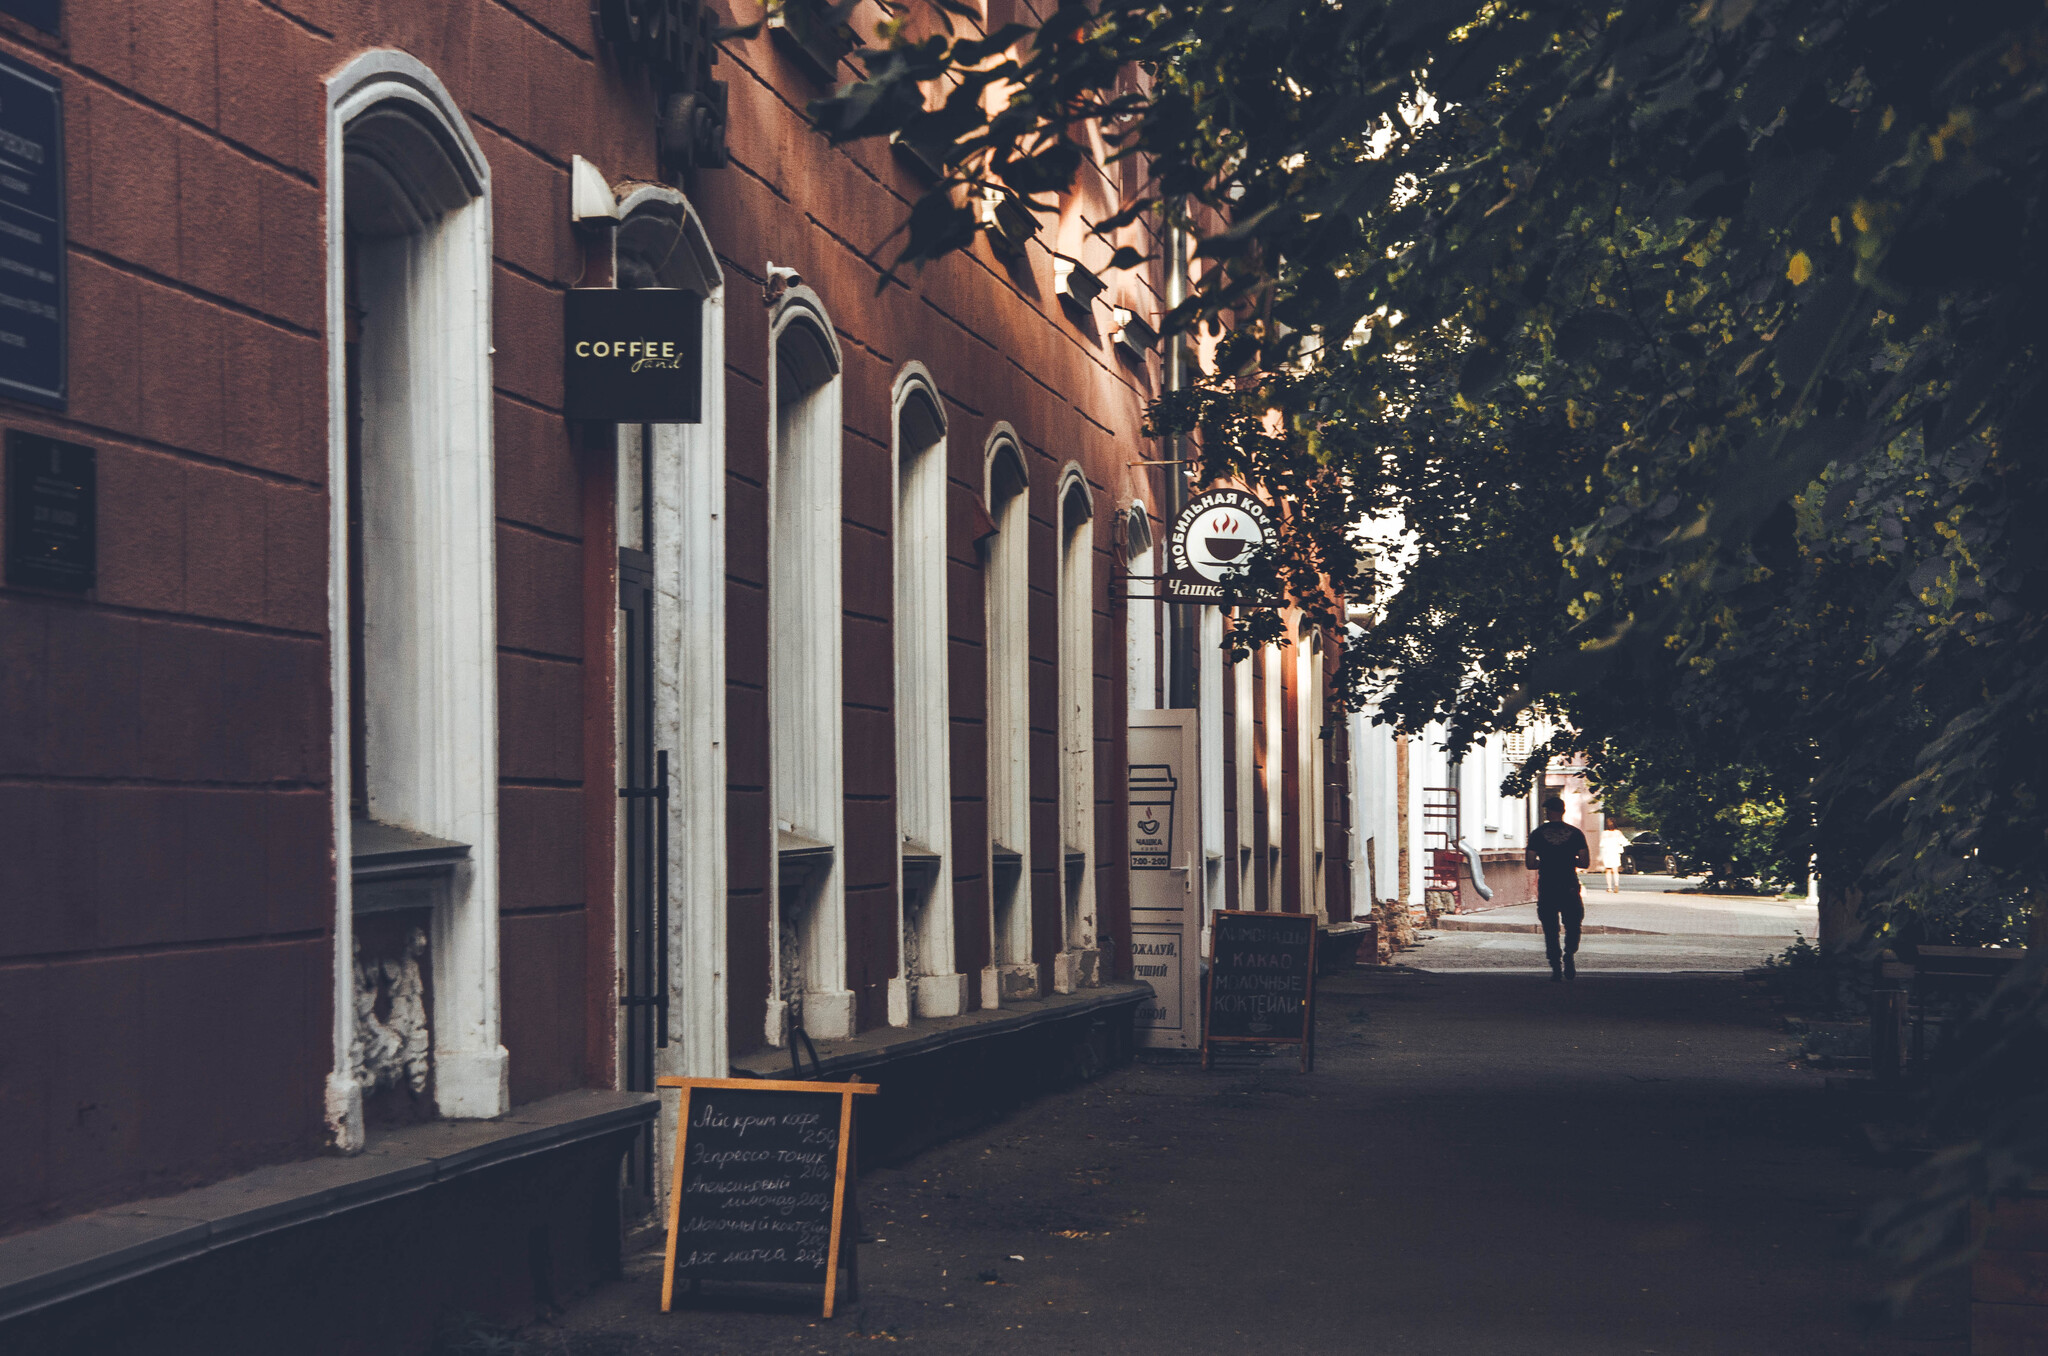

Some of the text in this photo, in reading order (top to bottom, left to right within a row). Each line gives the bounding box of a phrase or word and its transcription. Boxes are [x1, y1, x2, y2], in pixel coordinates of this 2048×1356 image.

[575, 340, 676, 358] COFFEE
[1171, 492, 1238, 571] МОБИЛЬНАЯ
[1131, 942, 1177, 957] ОЖАЛУЙ,
[1233, 951, 1293, 969] КАКАО
[1215, 974, 1302, 991] МОЛОЧНЫЕ
[1214, 991, 1299, 1014] КОКТЕЙЛИ
